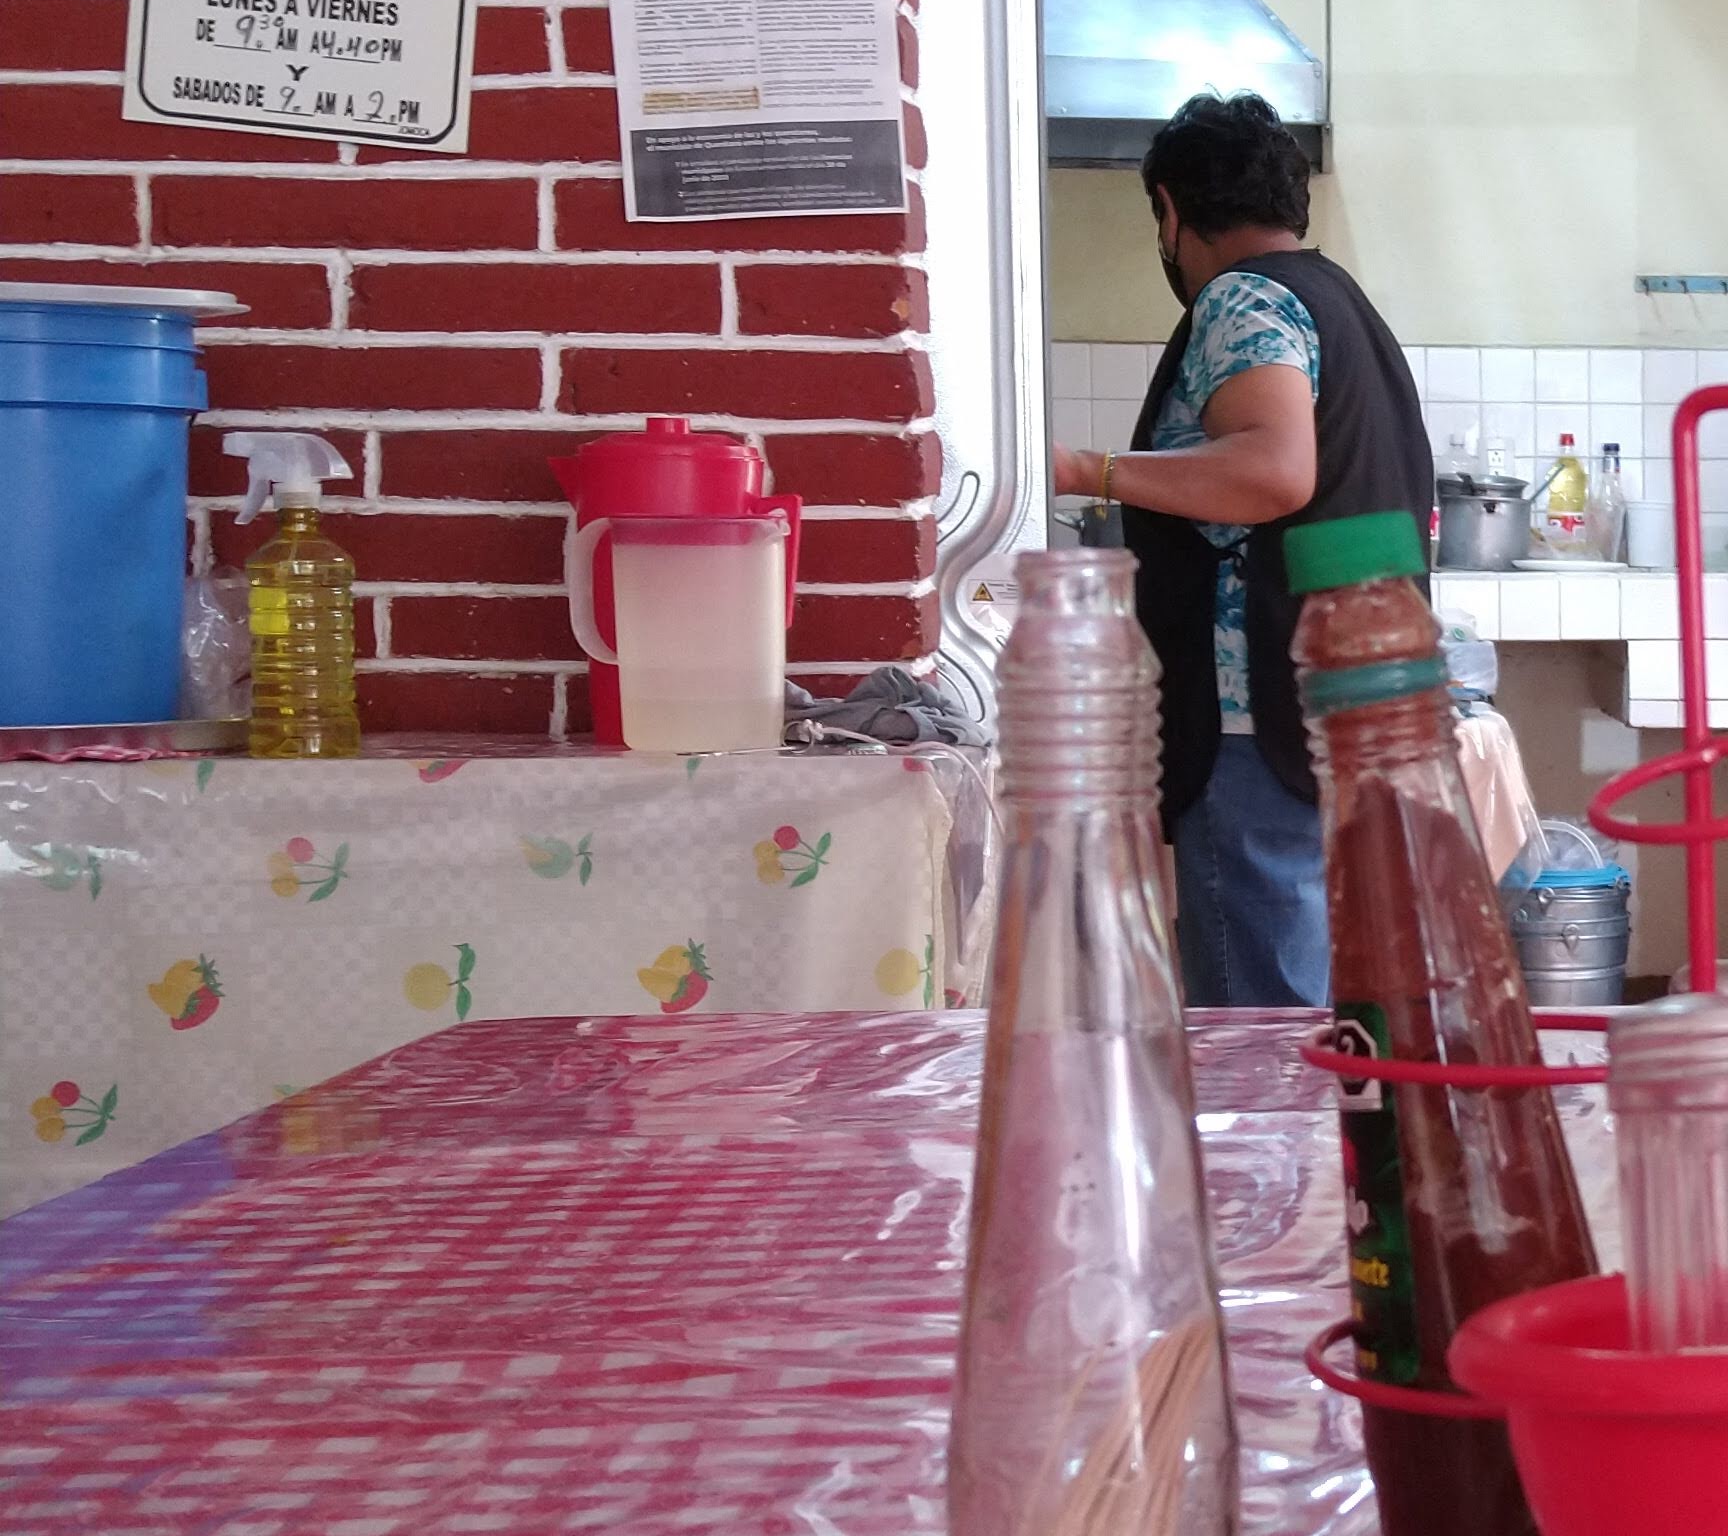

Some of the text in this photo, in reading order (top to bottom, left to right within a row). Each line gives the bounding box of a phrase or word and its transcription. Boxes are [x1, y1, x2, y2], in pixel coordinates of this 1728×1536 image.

[196, 18, 215, 42] DE
[275, 28, 298, 52] AM
[310, 33, 320, 55] A
[380, 38, 402, 62] PM
[286, 64, 309, 82] Y
[173, 76, 242, 106] SABADOS
[246, 85, 265, 107] DE
[314, 91, 336, 115] AM
[343, 94, 354, 117] A
[398, 100, 420, 124] PM
